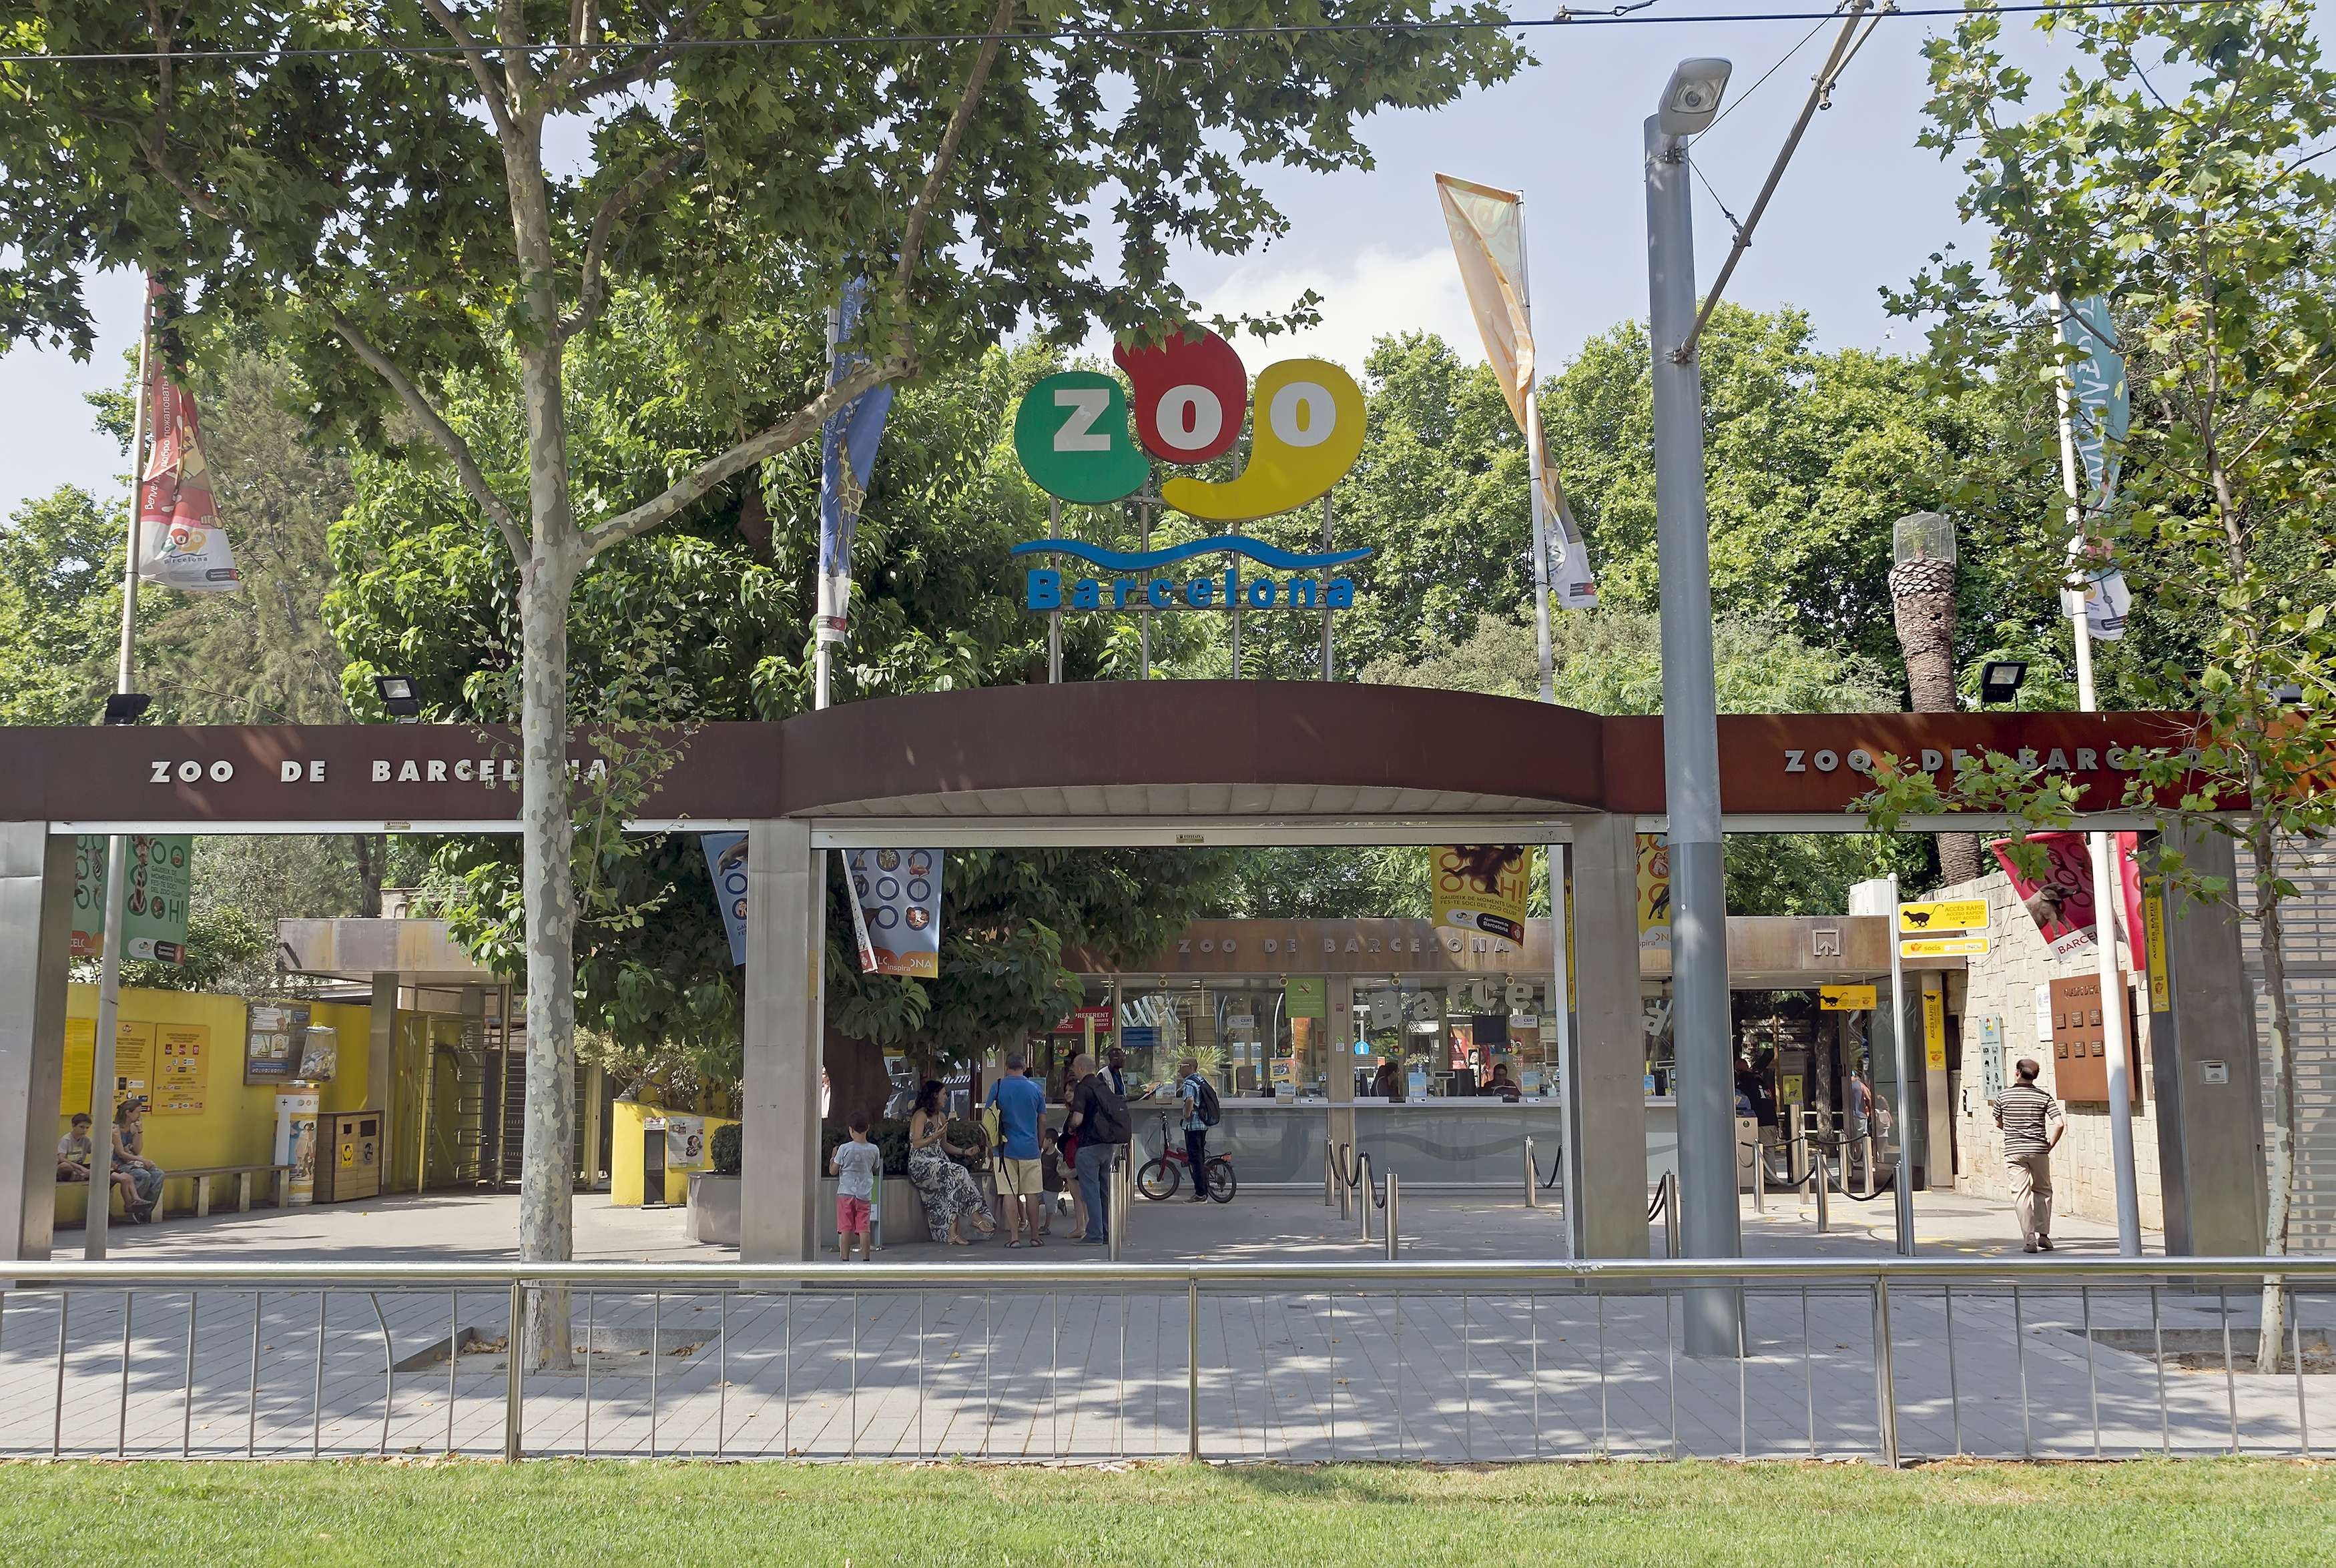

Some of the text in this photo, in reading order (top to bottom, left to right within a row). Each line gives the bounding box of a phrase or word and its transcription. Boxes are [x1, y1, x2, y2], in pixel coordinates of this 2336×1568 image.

[162, 381, 171, 438] пожаловать
[1027, 568, 1354, 610] Barcelona
[1784, 749, 1872, 772] ZOO
[150, 759, 610, 783] ZOO DE BARCELNA
[1477, 897, 1504, 907] MOMENTS
[1483, 921, 1508, 933] Barcelona
[1178, 938, 1510, 953] ZOO DE BARCELONA
[888, 963, 911, 972] inspira
